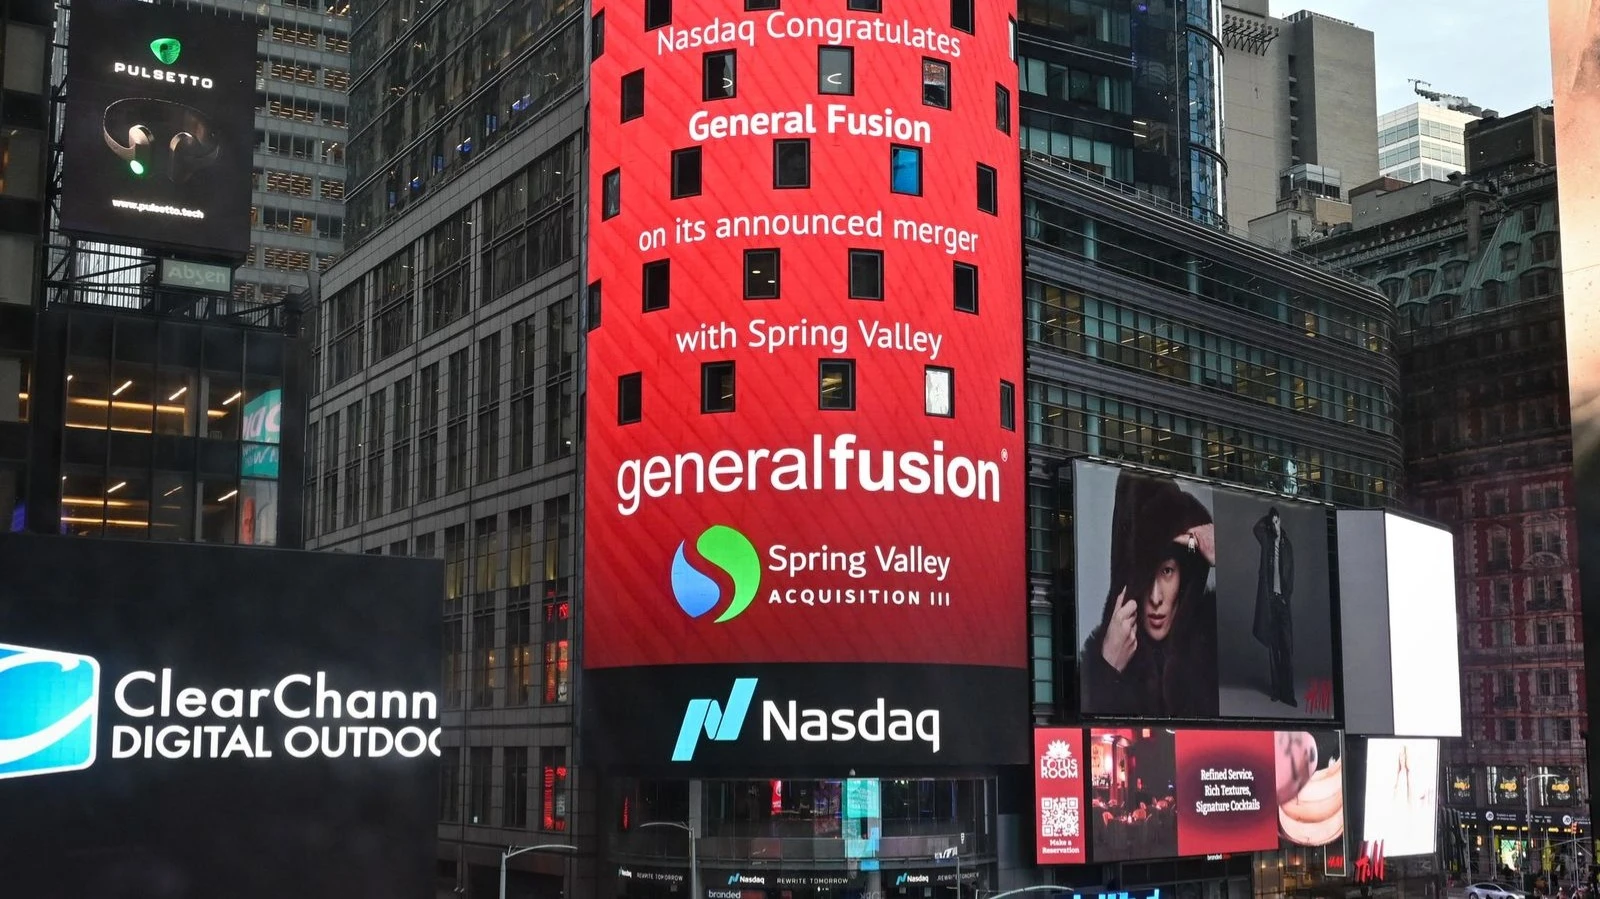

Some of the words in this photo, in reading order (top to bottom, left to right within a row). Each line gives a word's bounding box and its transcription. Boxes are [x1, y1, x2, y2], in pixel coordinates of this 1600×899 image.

[658, 17, 754, 56] Nasdaq
[766, 11, 961, 57] Congratulates
[114, 62, 213, 89] PULSETTO
[688, 104, 816, 141] General
[827, 104, 931, 143] Fusion
[112, 198, 205, 219] www.pulsetto.tech
[638, 227, 666, 252] on
[675, 218, 706, 243] its
[715, 211, 882, 239] announced
[893, 219, 979, 254] merger
[168, 264, 227, 286] Absen
[675, 322, 737, 353] with
[748, 318, 848, 354] Spring
[857, 319, 943, 360] Valley
[768, 544, 867, 579] Spring
[875, 545, 951, 582] Valley
[768, 588, 920, 605] ACQUISITION
[930, 591, 951, 607] III
[114, 667, 437, 720] ClearChann
[762, 697, 940, 754] Nasdaq
[112, 724, 273, 759] DIGITAL
[1041, 757, 1078, 770] LOTUS
[1041, 768, 1078, 779] ROOM
[1200, 768, 1228, 780] Refined
[1228, 768, 1254, 781] Service,
[1204, 784, 1220, 797] Rich
[1220, 784, 1251, 797] Textures,
[1195, 800, 1230, 816] Signature
[1230, 798, 1261, 811] Cocktails
[739, 875, 765, 885] Nasdaq
[776, 877, 807, 885] REWRITE
[810, 877, 849, 885] TOMORROW
[906, 874, 930, 883] Nasdaq
[708, 889, 742, 899] branded
